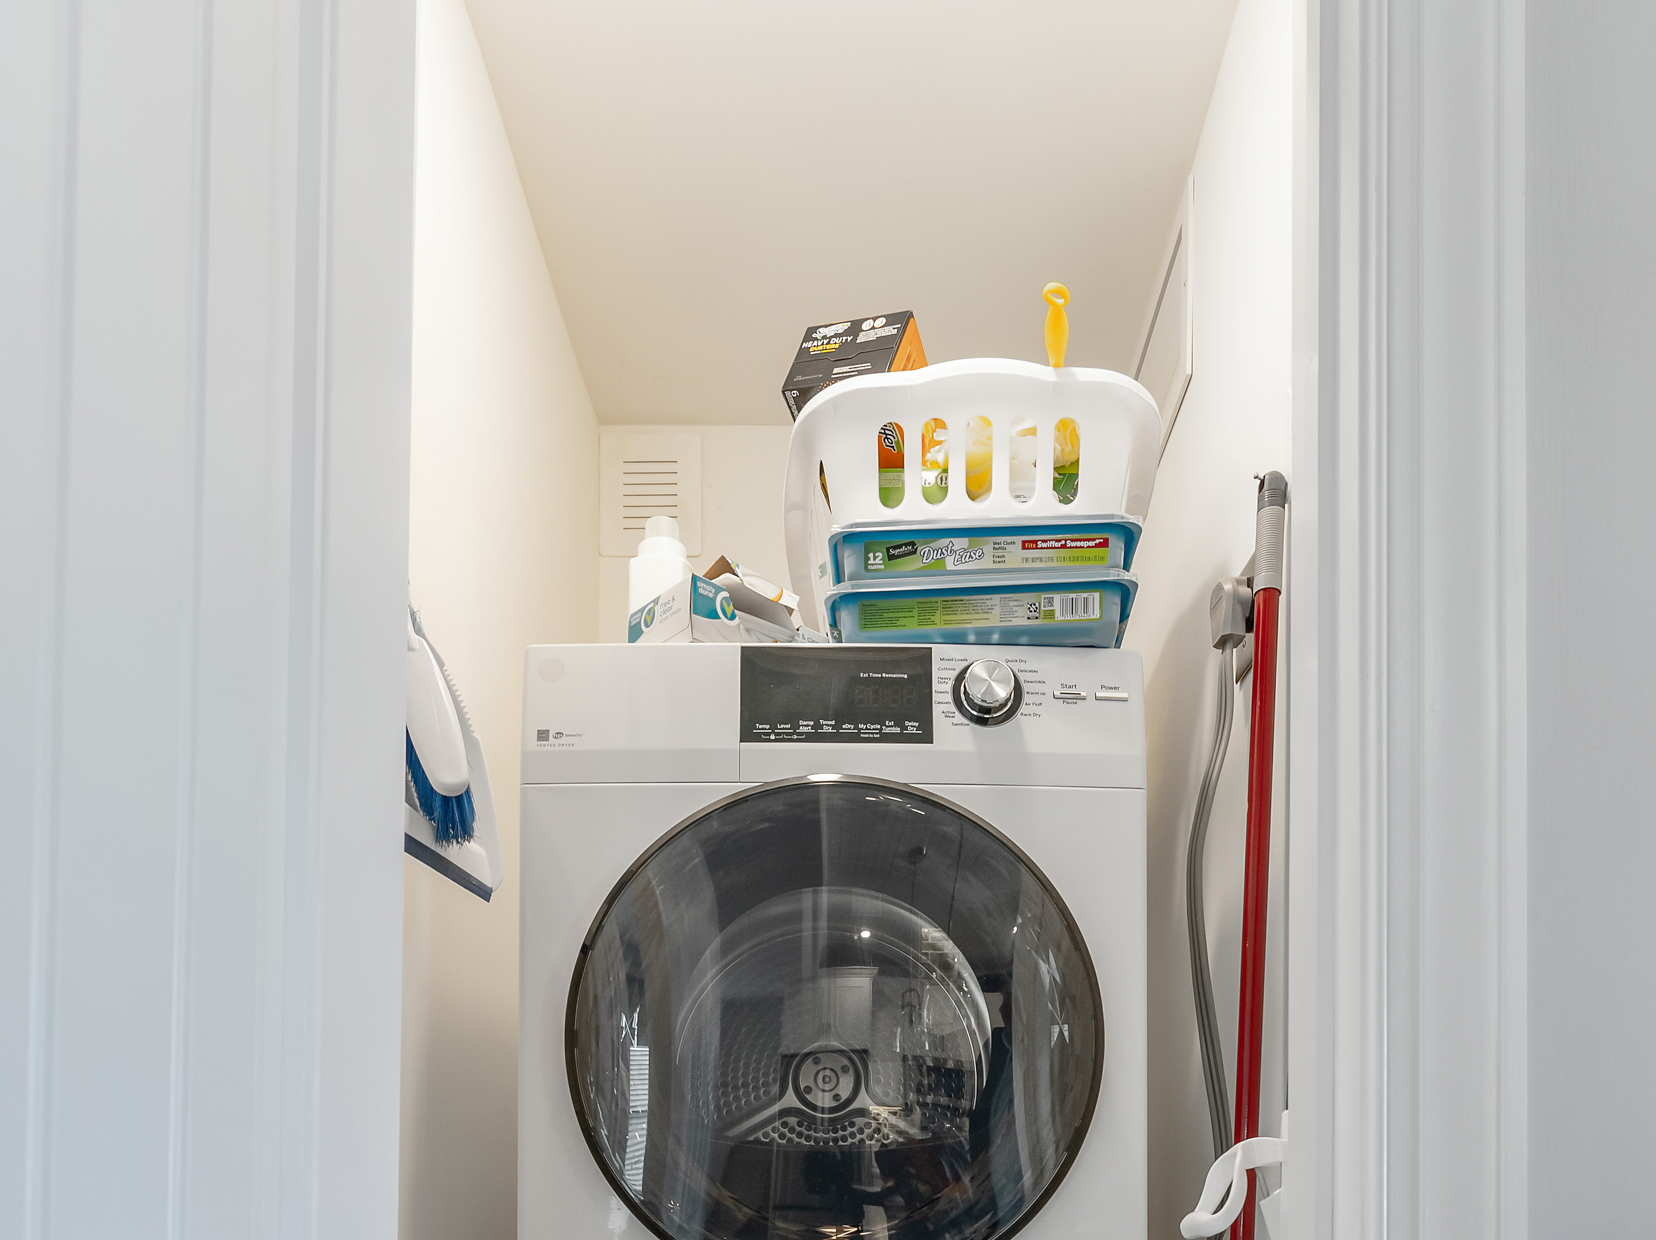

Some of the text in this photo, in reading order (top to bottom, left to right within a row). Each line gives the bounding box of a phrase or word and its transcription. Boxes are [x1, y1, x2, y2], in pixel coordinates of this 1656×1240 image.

[802, 336, 854, 349] HEAVY DUTY
[868, 552, 883, 564] 12
[920, 541, 955, 564] Dust
[953, 546, 985, 566] Ease
